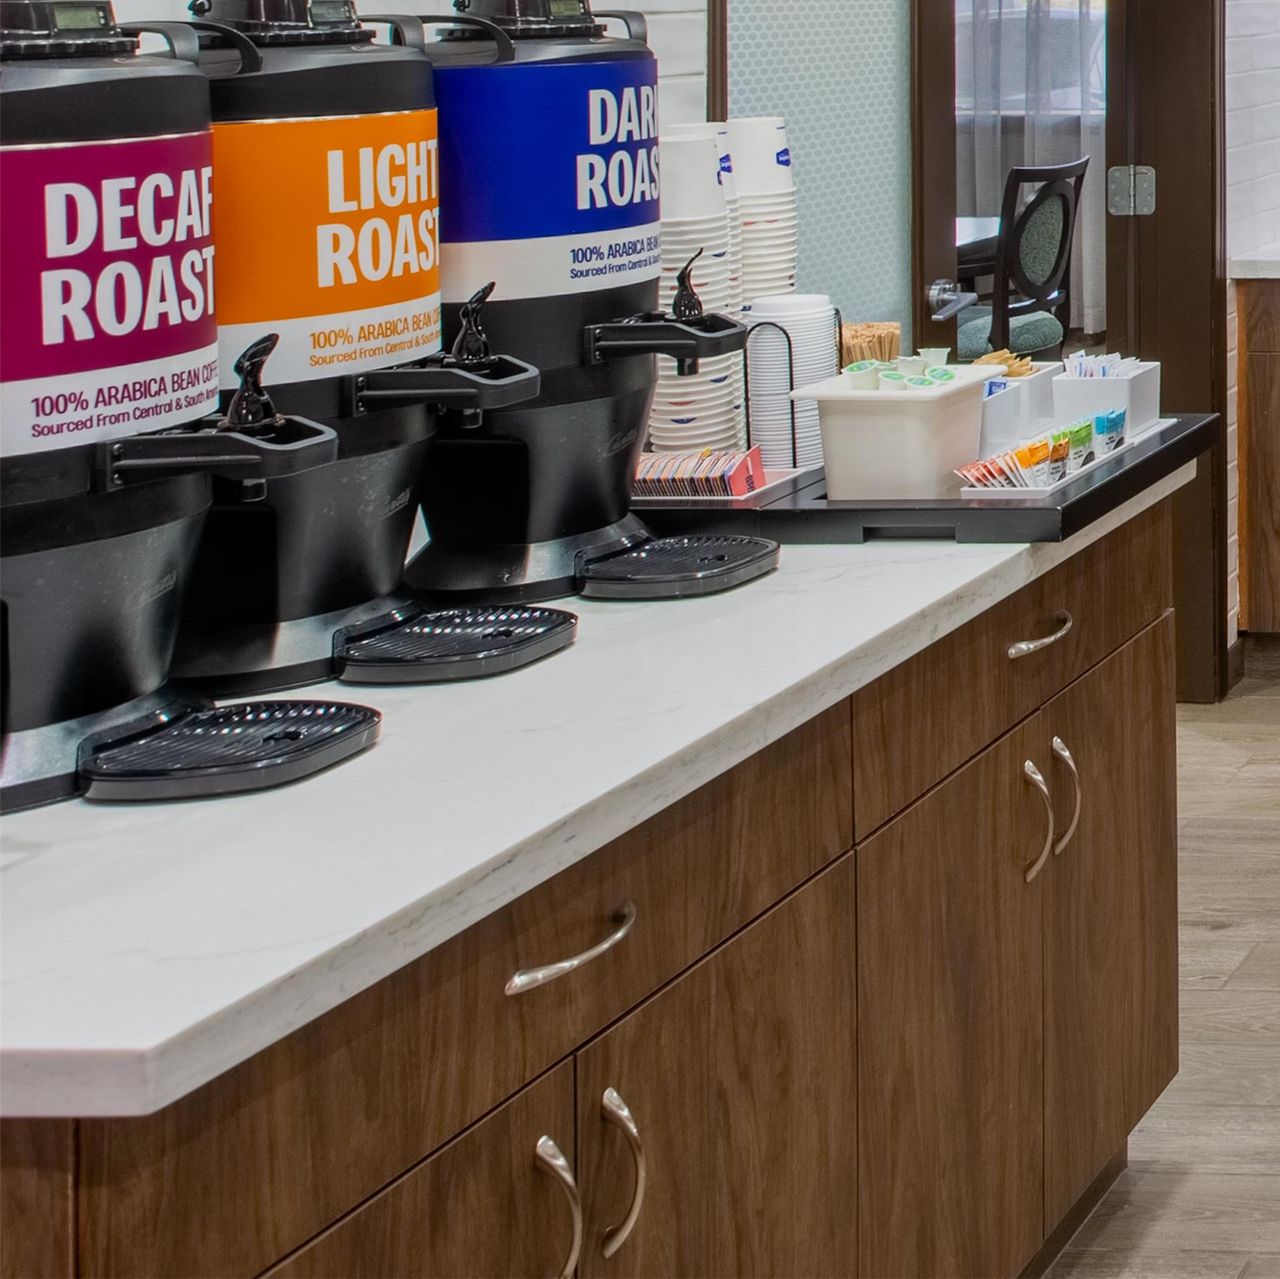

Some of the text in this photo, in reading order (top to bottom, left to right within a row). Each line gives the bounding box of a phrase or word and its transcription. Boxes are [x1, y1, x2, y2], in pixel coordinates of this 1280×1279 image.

[327, 138, 438, 213] LIGHT
[44, 166, 213, 259] DECAF
[316, 207, 439, 288] ROAST
[570, 246, 604, 264] 100%
[607, 238, 646, 260] ARABICA
[570, 264, 607, 279] Sourced
[608, 263, 627, 274] From
[41, 245, 215, 346] ROAST
[309, 327, 353, 350] 100%
[357, 317, 409, 343] ARABICA
[412, 311, 432, 332] BEAN
[309, 348, 357, 367] Sourced
[360, 346, 384, 359] From
[385, 337, 414, 354] Central
[31, 391, 89, 418] 100%
[94, 376, 168, 409] ARABICA
[172, 367, 200, 393] BEAN
[31, 416, 93, 438] Sourced
[97, 412, 129, 428] From
[133, 402, 173, 420] Central
[174, 398, 183, 410] &
